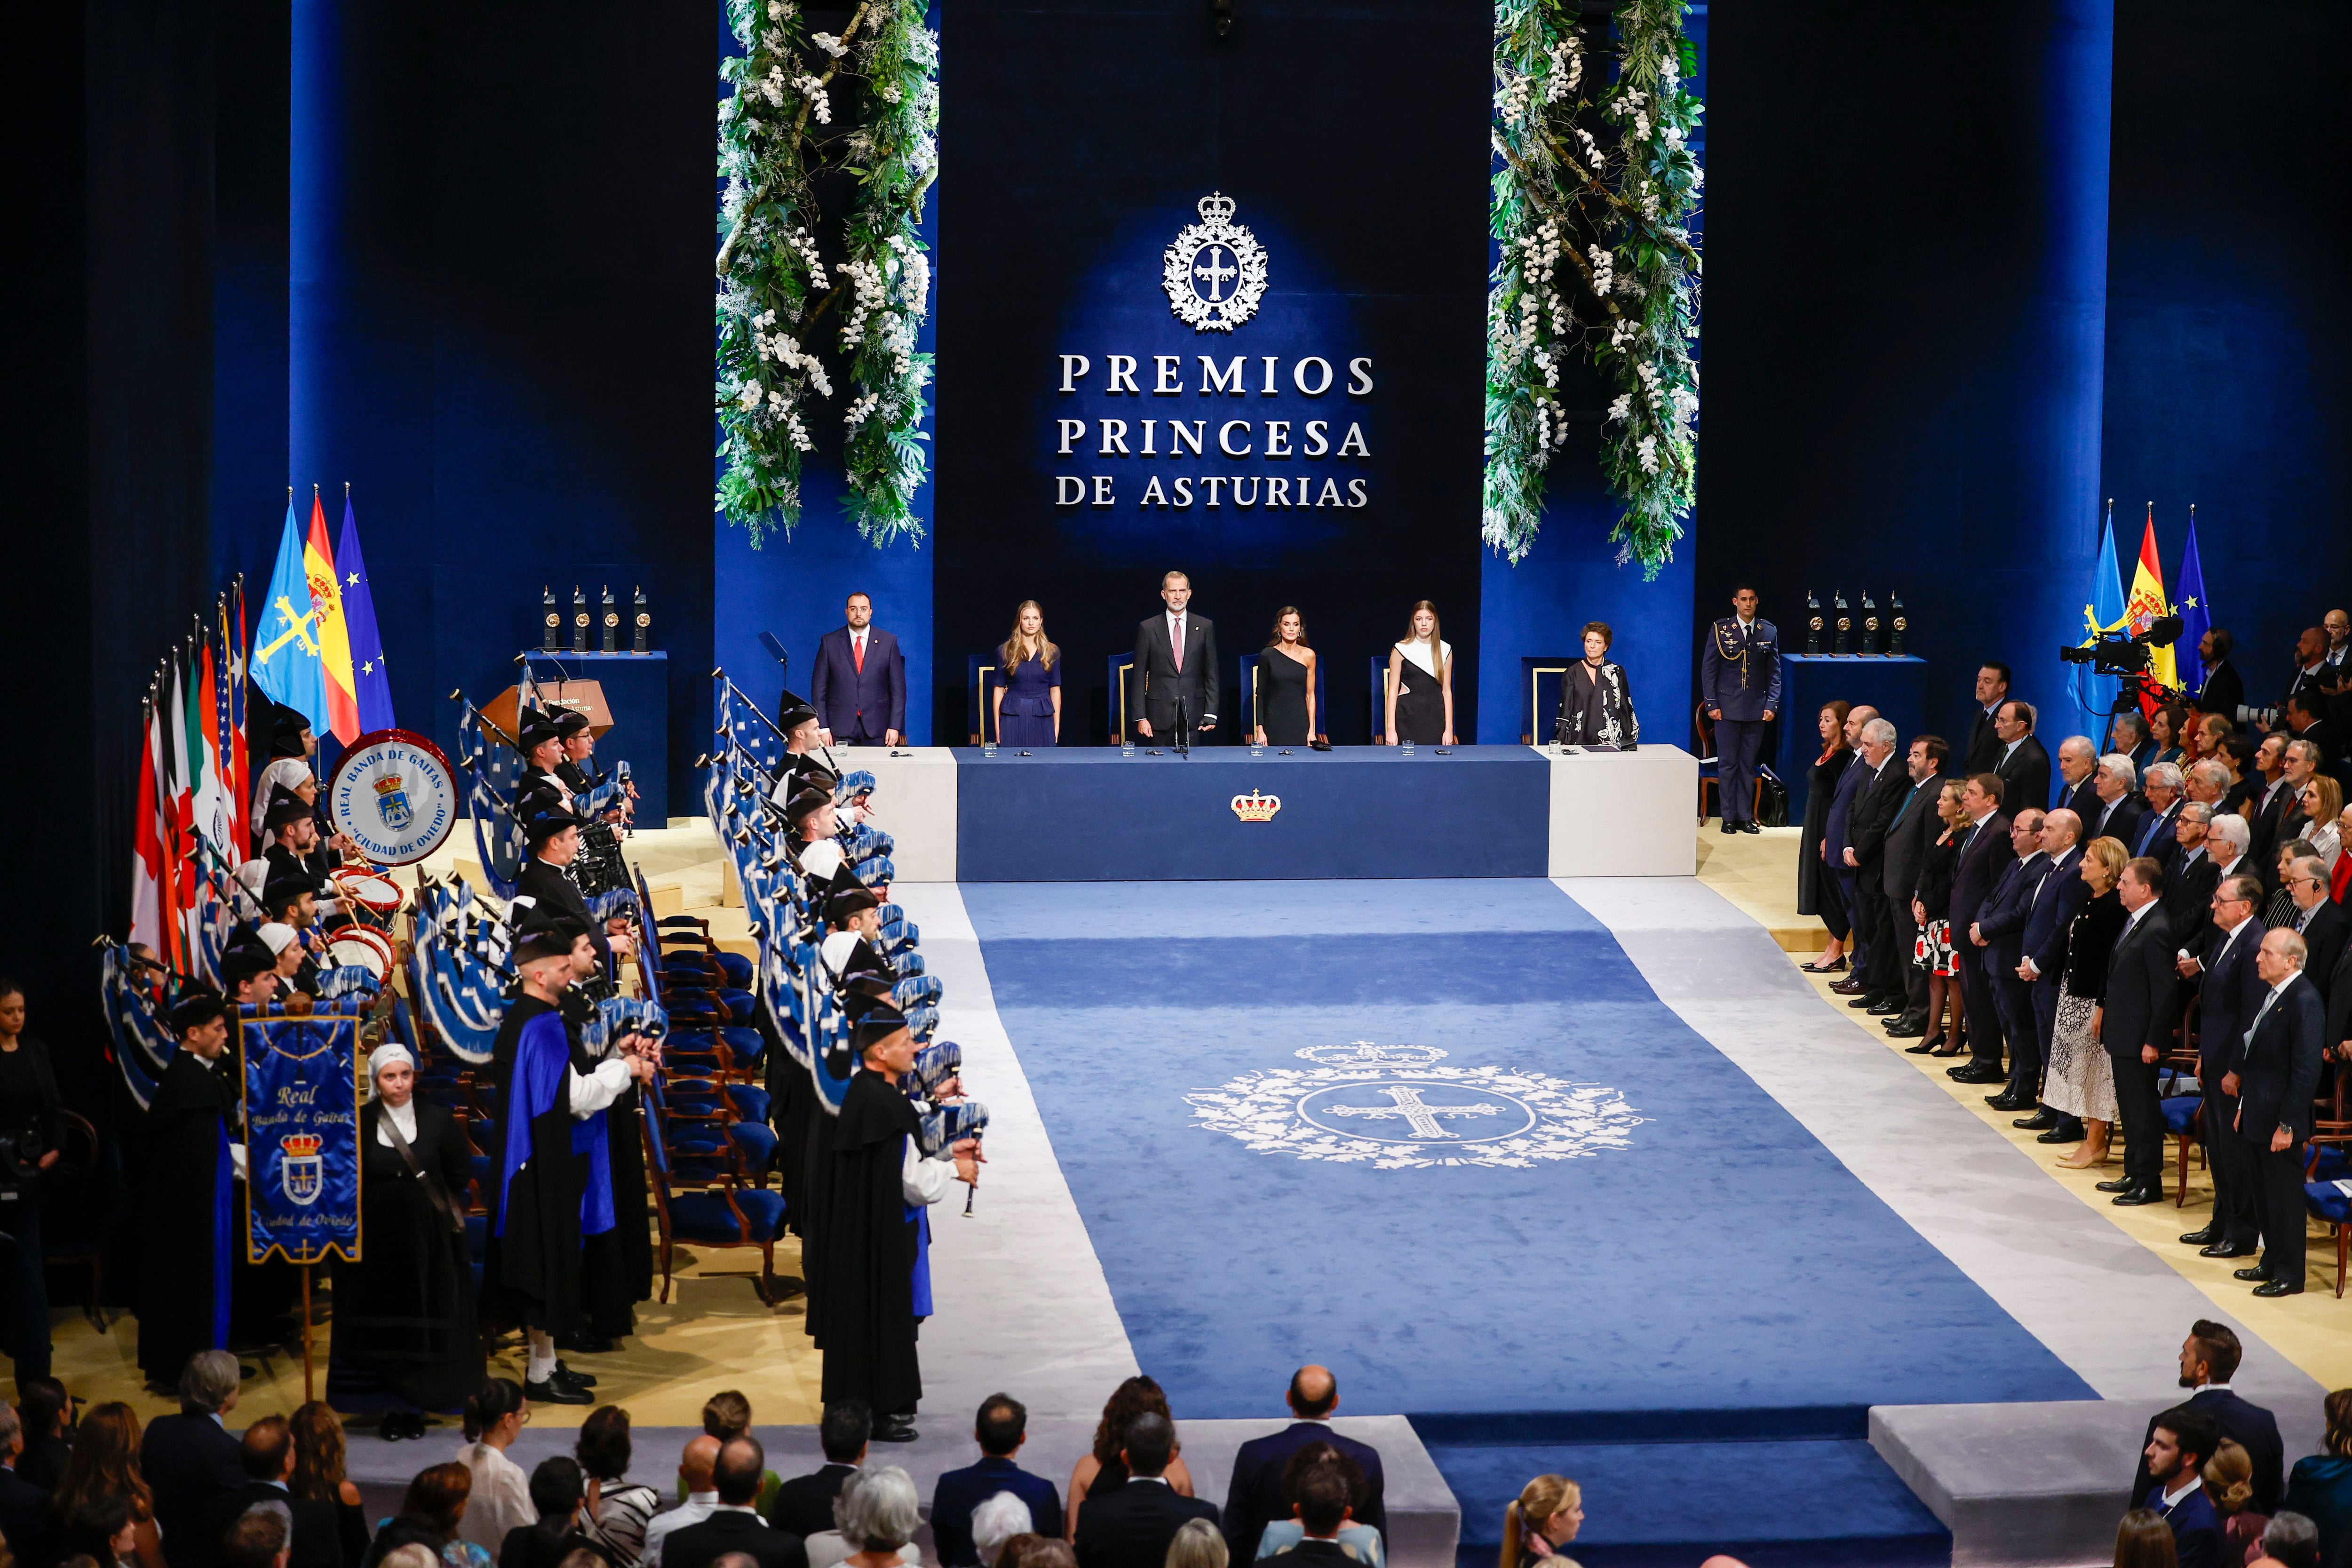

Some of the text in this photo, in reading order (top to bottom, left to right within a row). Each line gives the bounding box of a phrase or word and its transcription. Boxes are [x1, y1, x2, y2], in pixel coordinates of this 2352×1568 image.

[1058, 354, 1374, 395] PREMIOS
[1057, 419, 1371, 456] PRINCESA
[1055, 475, 1368, 507] DE ASTURIAS
[340, 750, 443, 817] REAL BANDA DE GAITAS
[353, 828, 396, 855] “CIUDAD
[400, 842, 416, 854] DE
[417, 803, 446, 847] OVIEDO”
[277, 1085, 319, 1108] Real
[252, 1109, 288, 1126] Banda
[294, 1109, 308, 1123] de
[257, 1213, 294, 1227] udad
